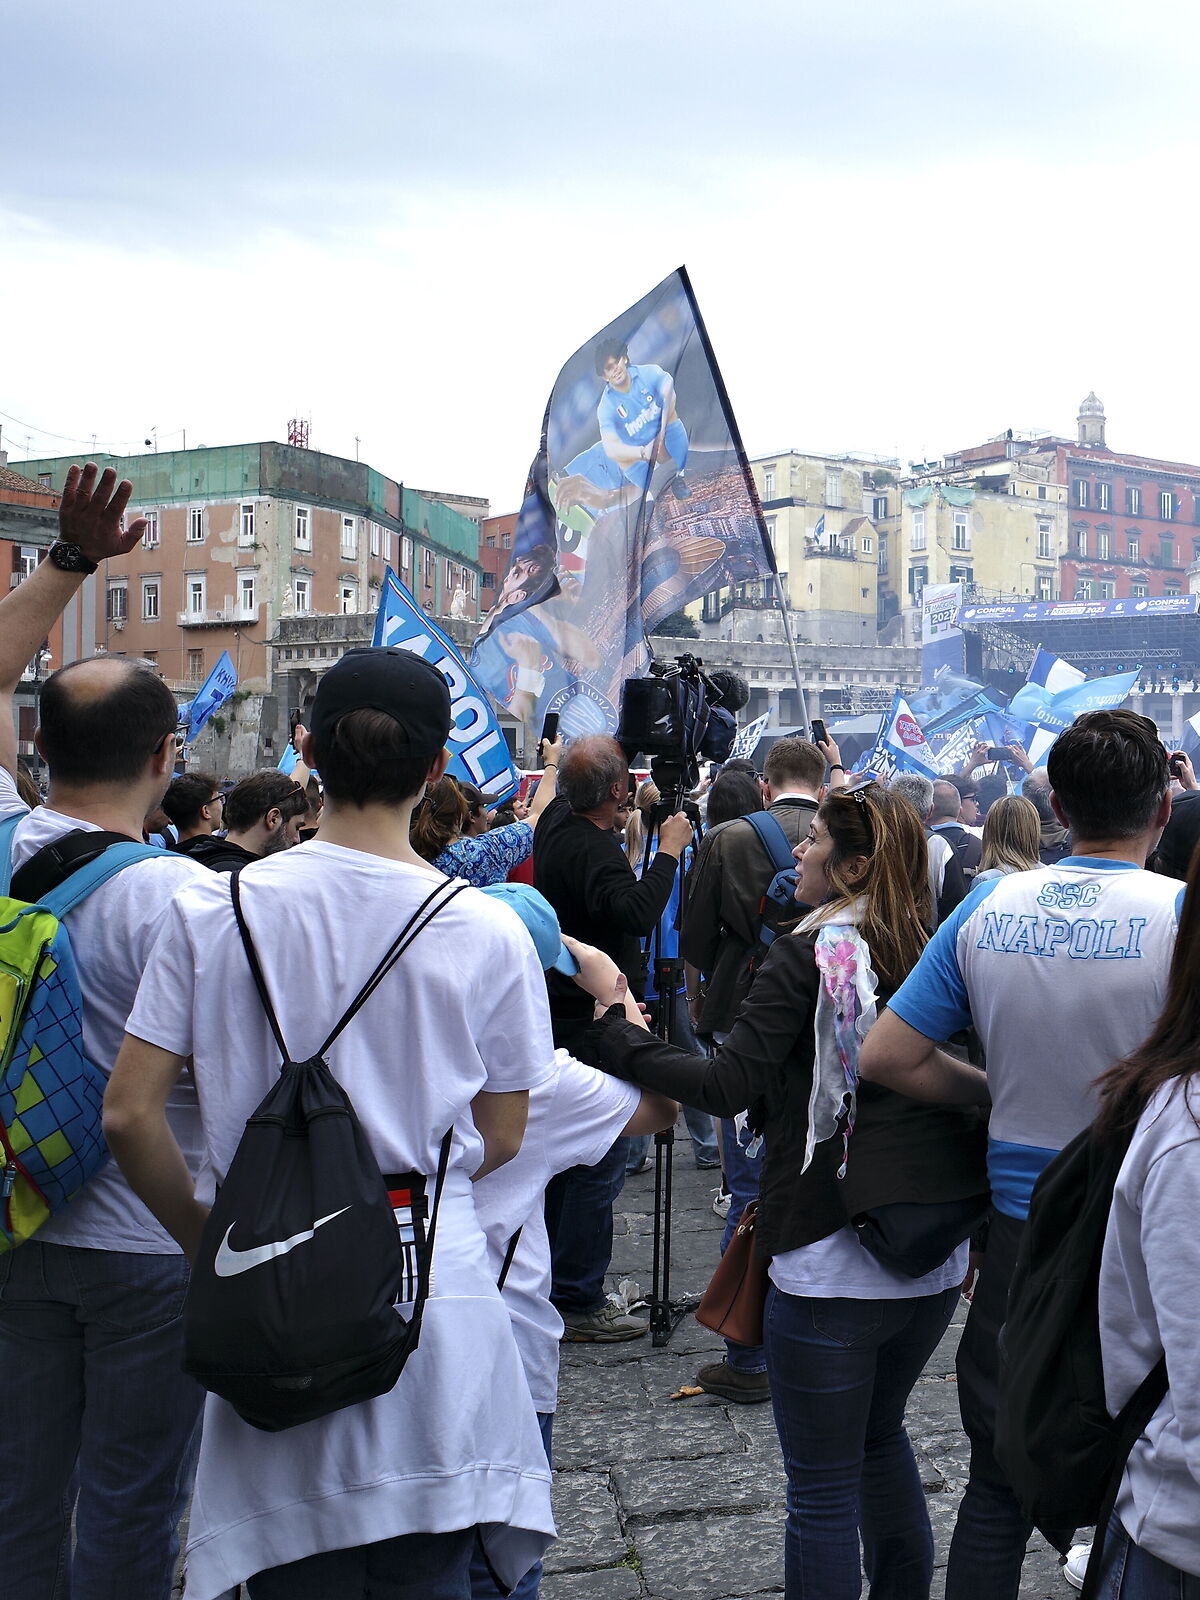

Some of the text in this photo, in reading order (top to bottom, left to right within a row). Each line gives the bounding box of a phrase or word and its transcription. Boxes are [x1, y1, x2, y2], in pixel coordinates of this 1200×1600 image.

[976, 606, 1016, 614] CONFSAL
[1148, 598, 1190, 606] CONFSAL
[1037, 882, 1101, 909] SSC
[977, 911, 1147, 960] NAPOLI
